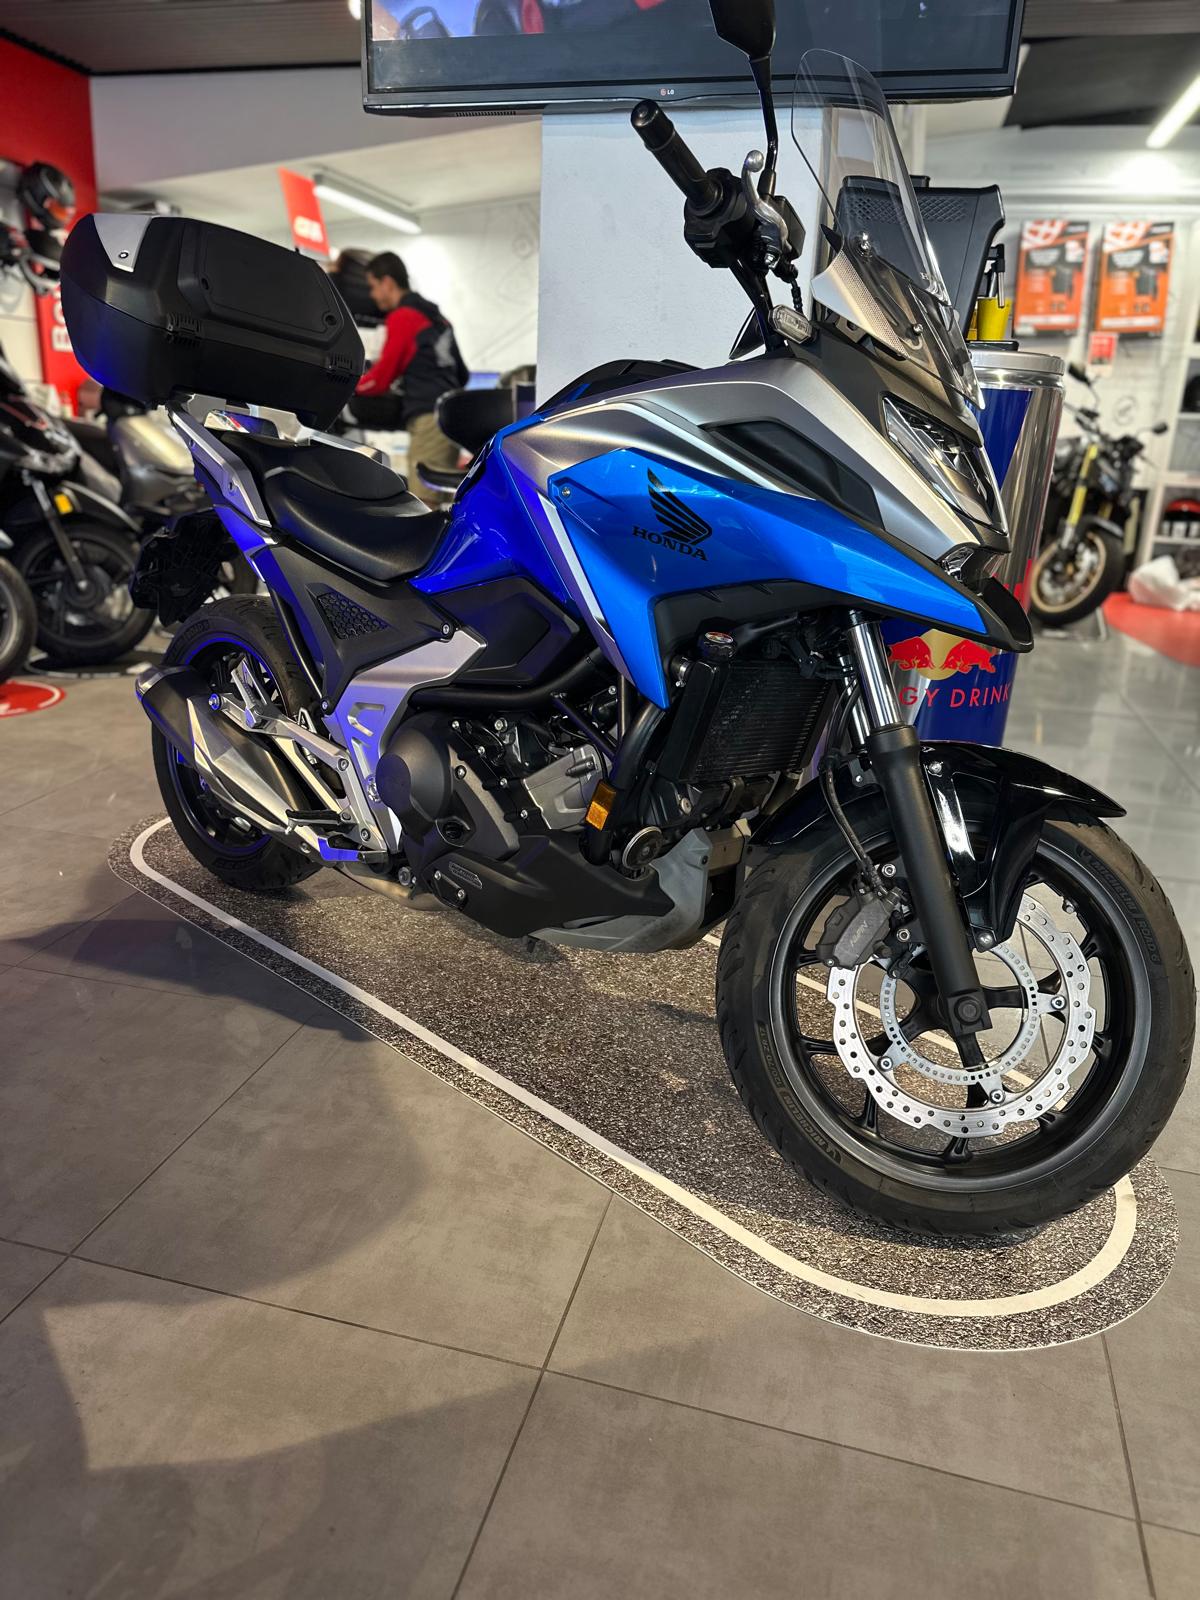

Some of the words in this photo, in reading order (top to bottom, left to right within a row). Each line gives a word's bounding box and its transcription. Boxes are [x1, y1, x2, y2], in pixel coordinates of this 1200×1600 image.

[632, 525, 708, 561] HONDA
[950, 682, 1011, 708] DRINK
[1090, 859, 1137, 912] MICHELIN
[783, 1095, 826, 1145] MICHELIN
